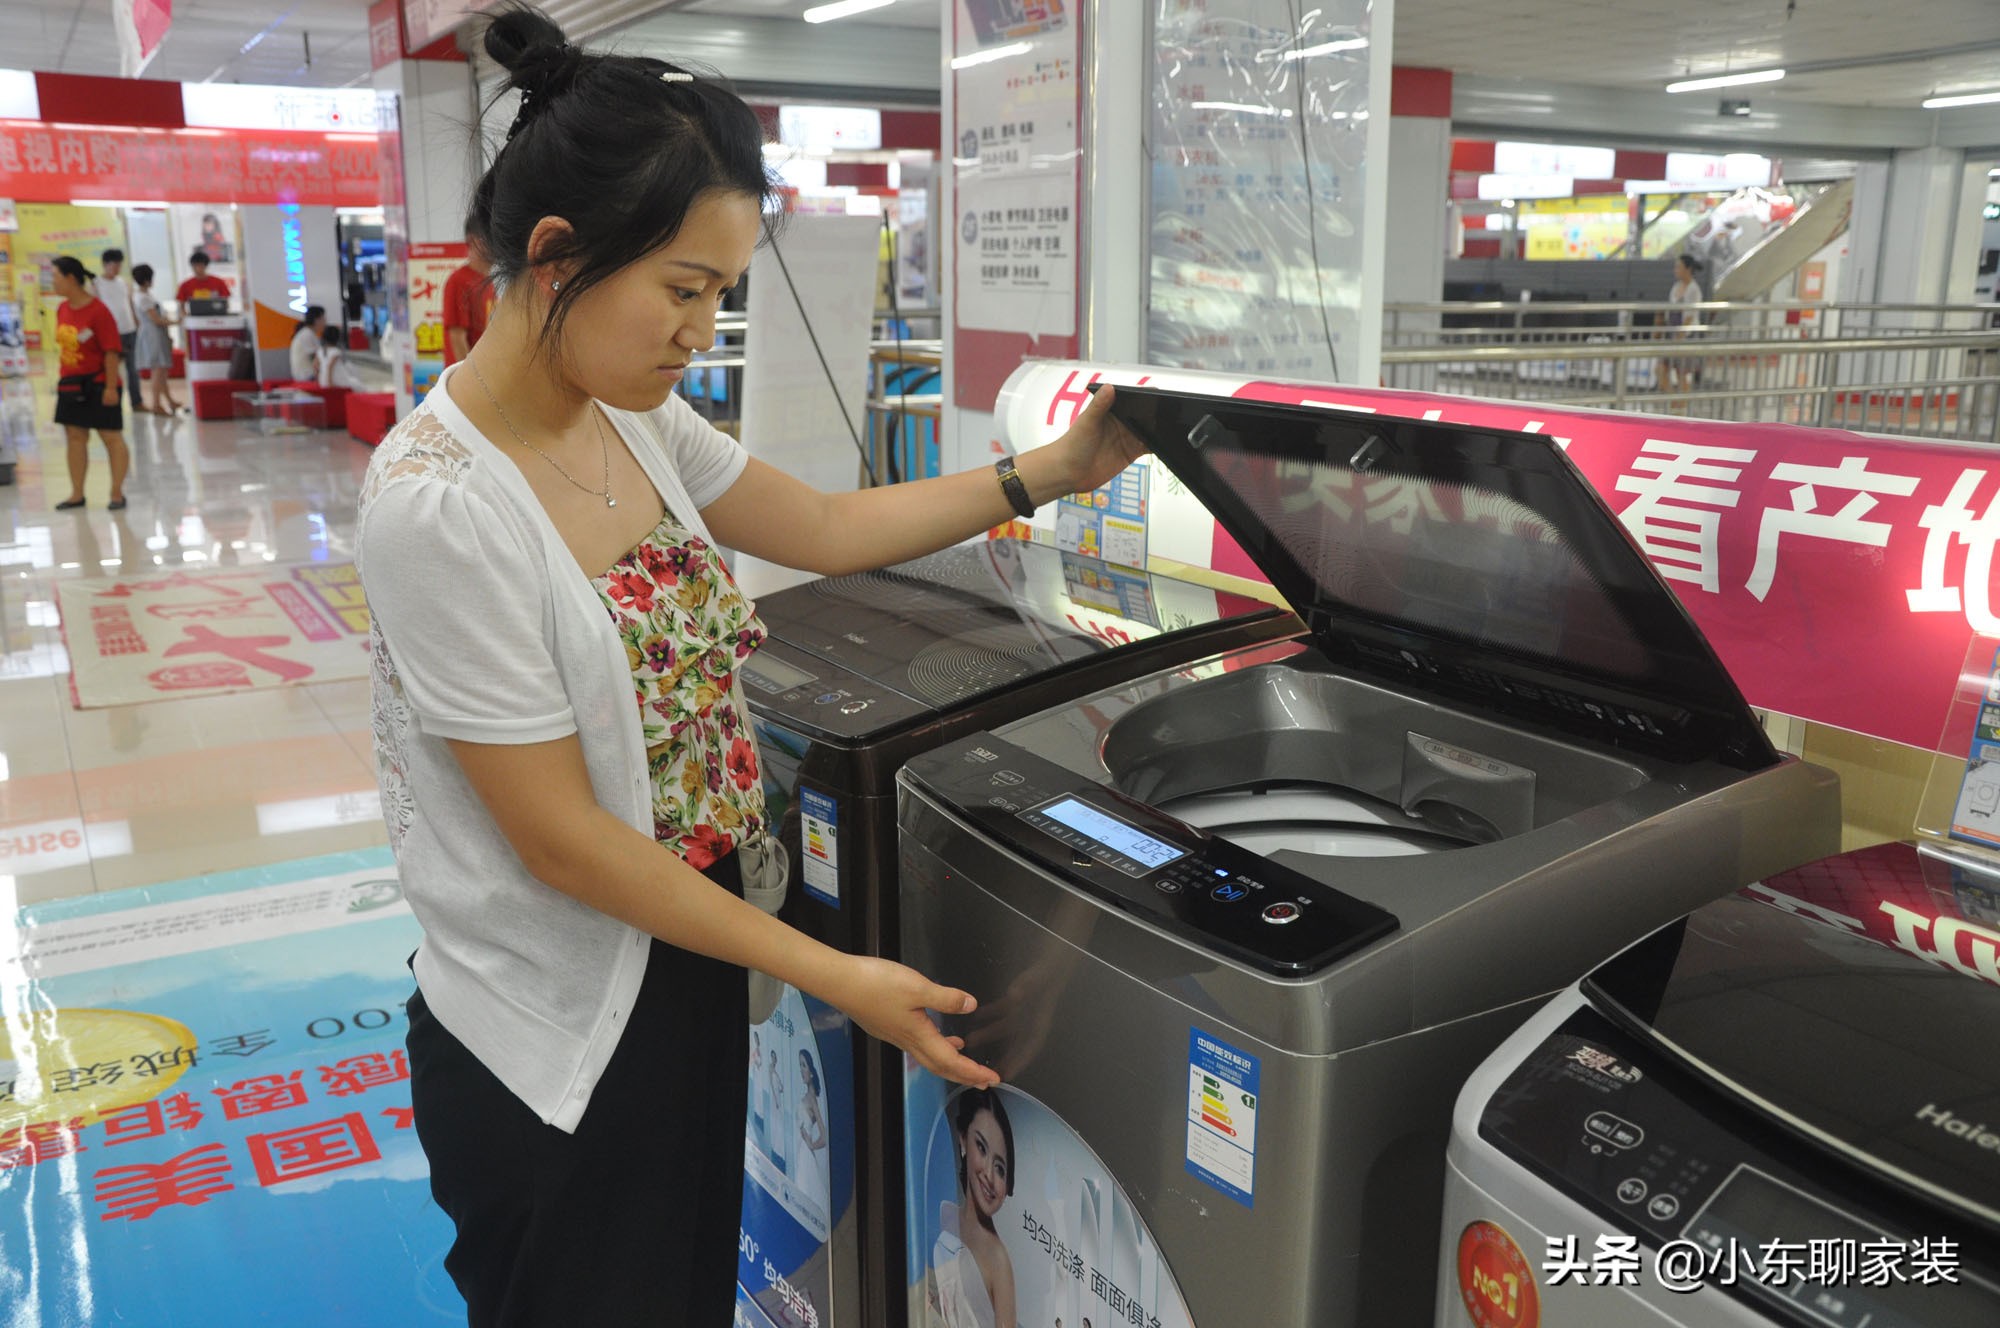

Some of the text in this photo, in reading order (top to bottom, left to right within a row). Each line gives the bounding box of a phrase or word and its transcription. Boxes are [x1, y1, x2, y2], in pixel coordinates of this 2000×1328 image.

[287, 285, 309, 314] TV
[1915, 1103, 2000, 1154] Haie
[1022, 1209, 1086, 1284] 均匀洗涤
